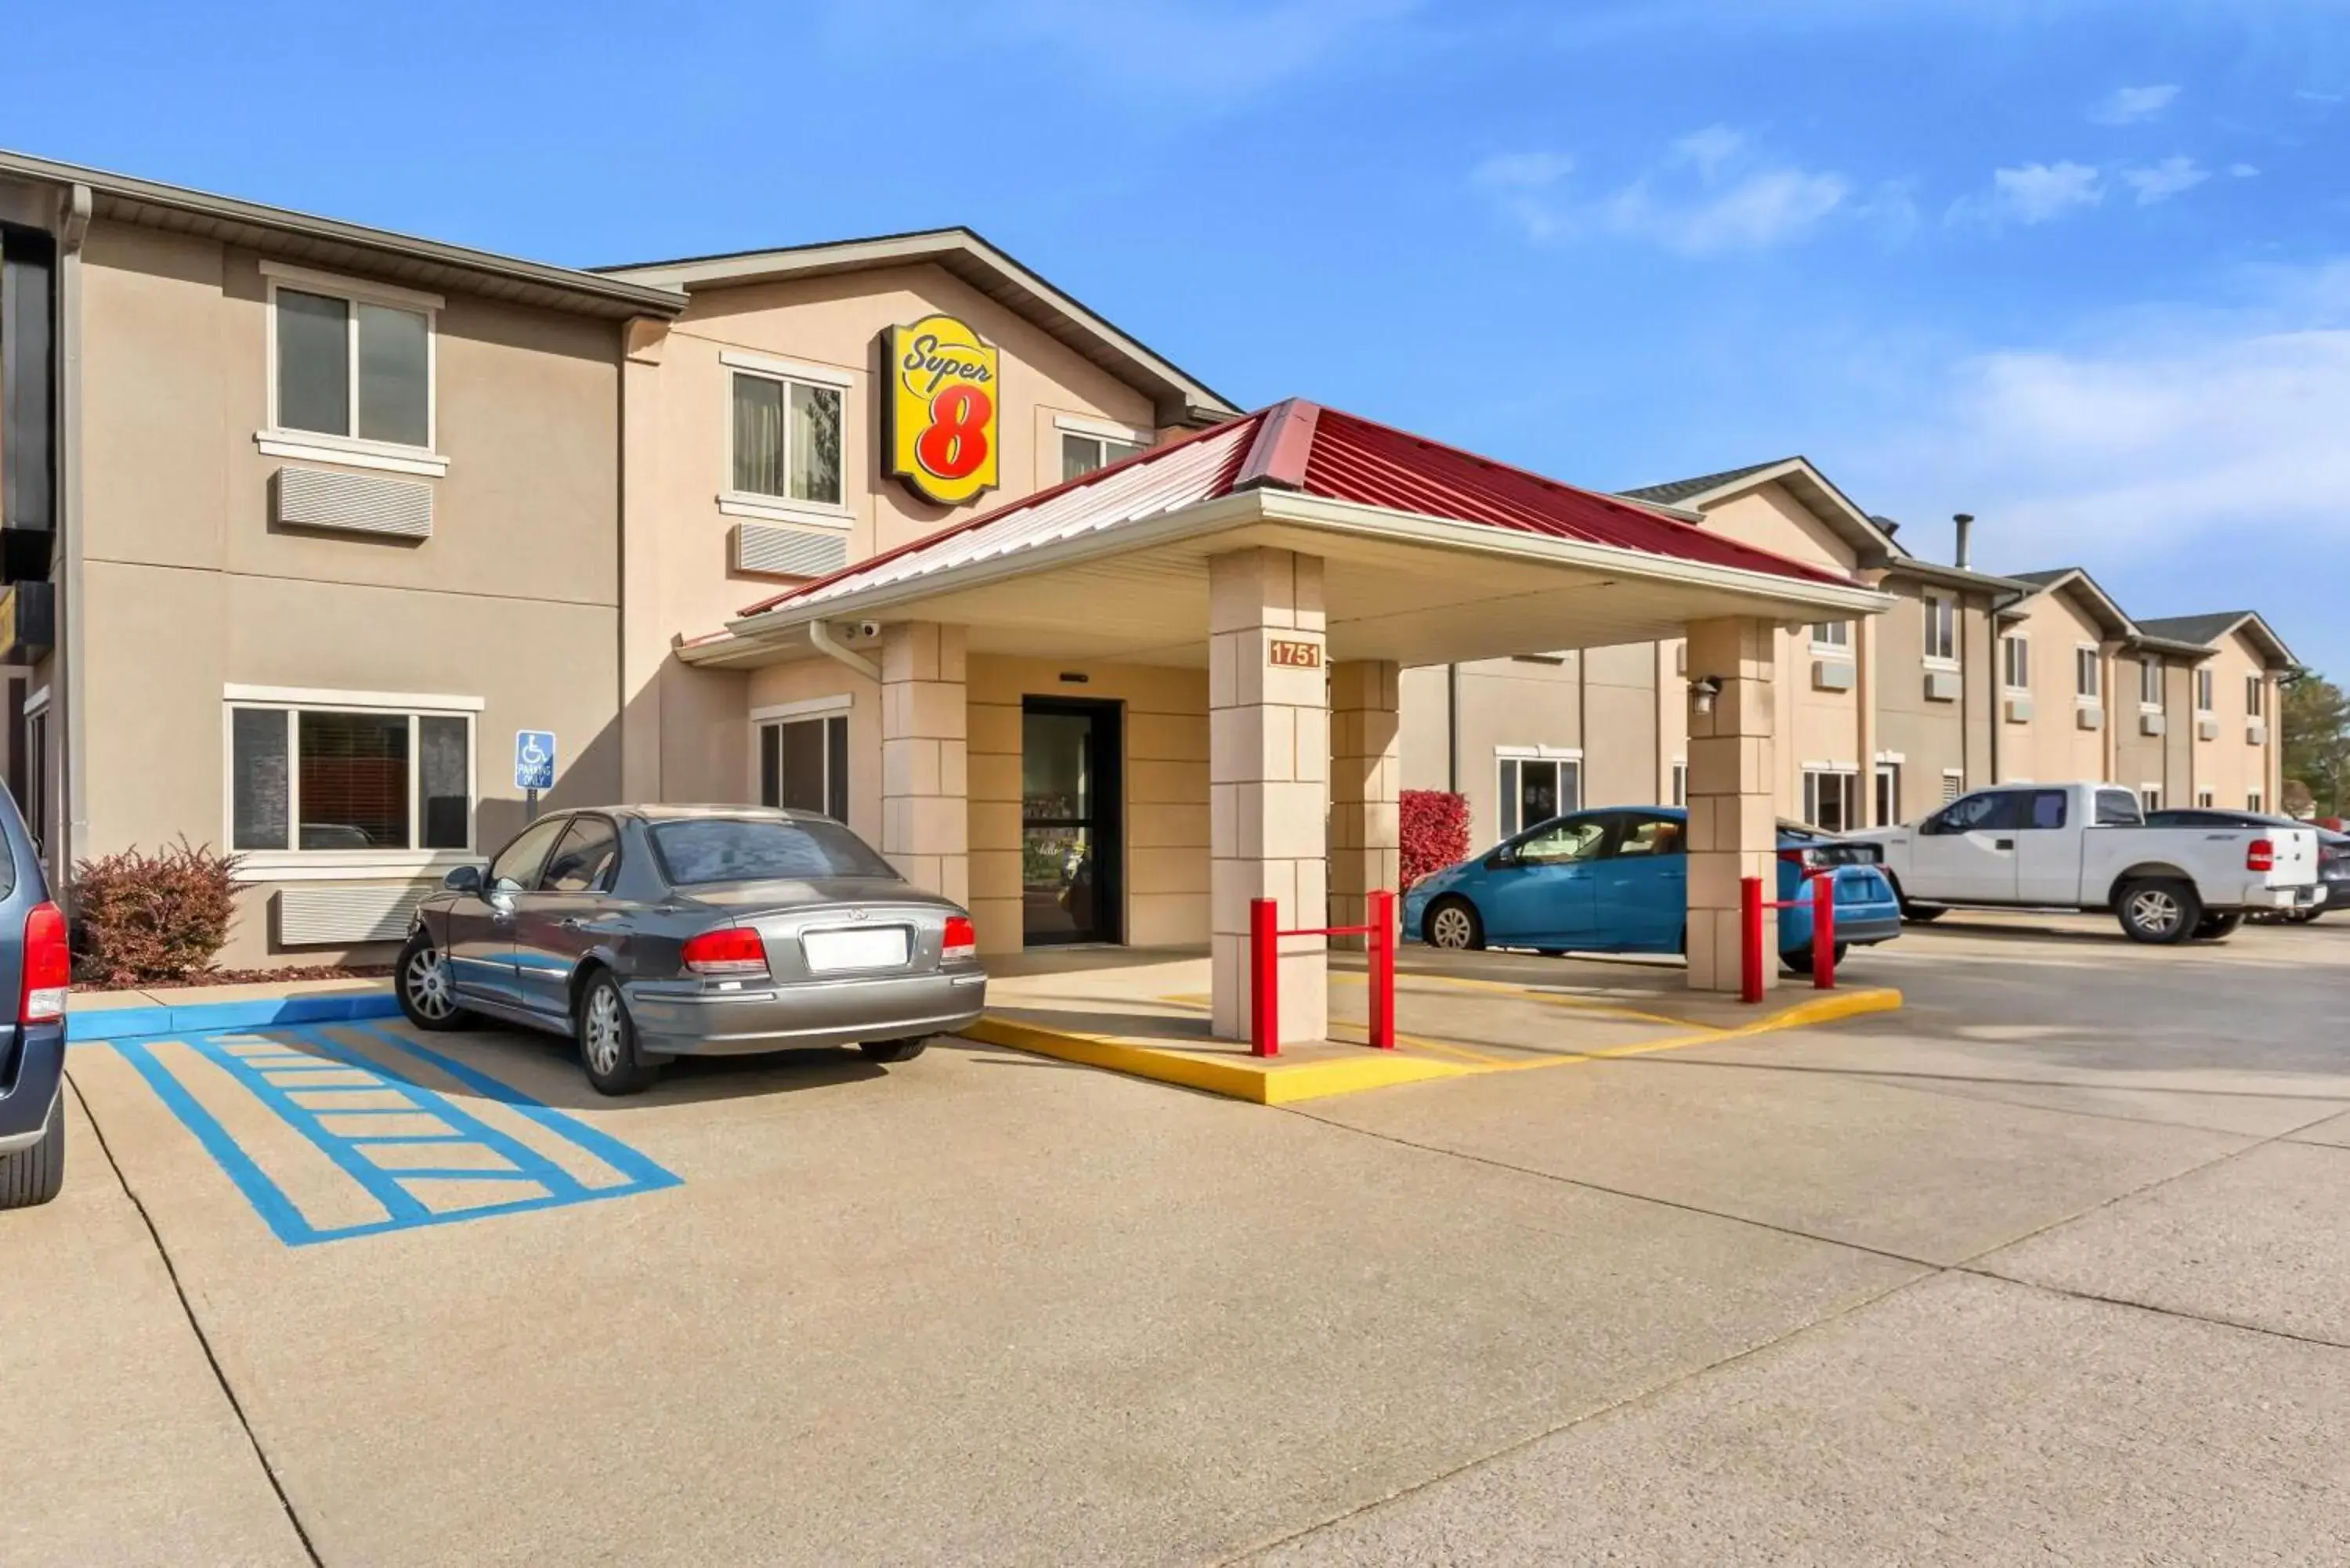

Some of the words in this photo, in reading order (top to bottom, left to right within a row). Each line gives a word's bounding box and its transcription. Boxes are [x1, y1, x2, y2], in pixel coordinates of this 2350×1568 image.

[902, 334, 992, 392] Super
[915, 384, 992, 480] 8
[1272, 641, 1318, 666] 1751
